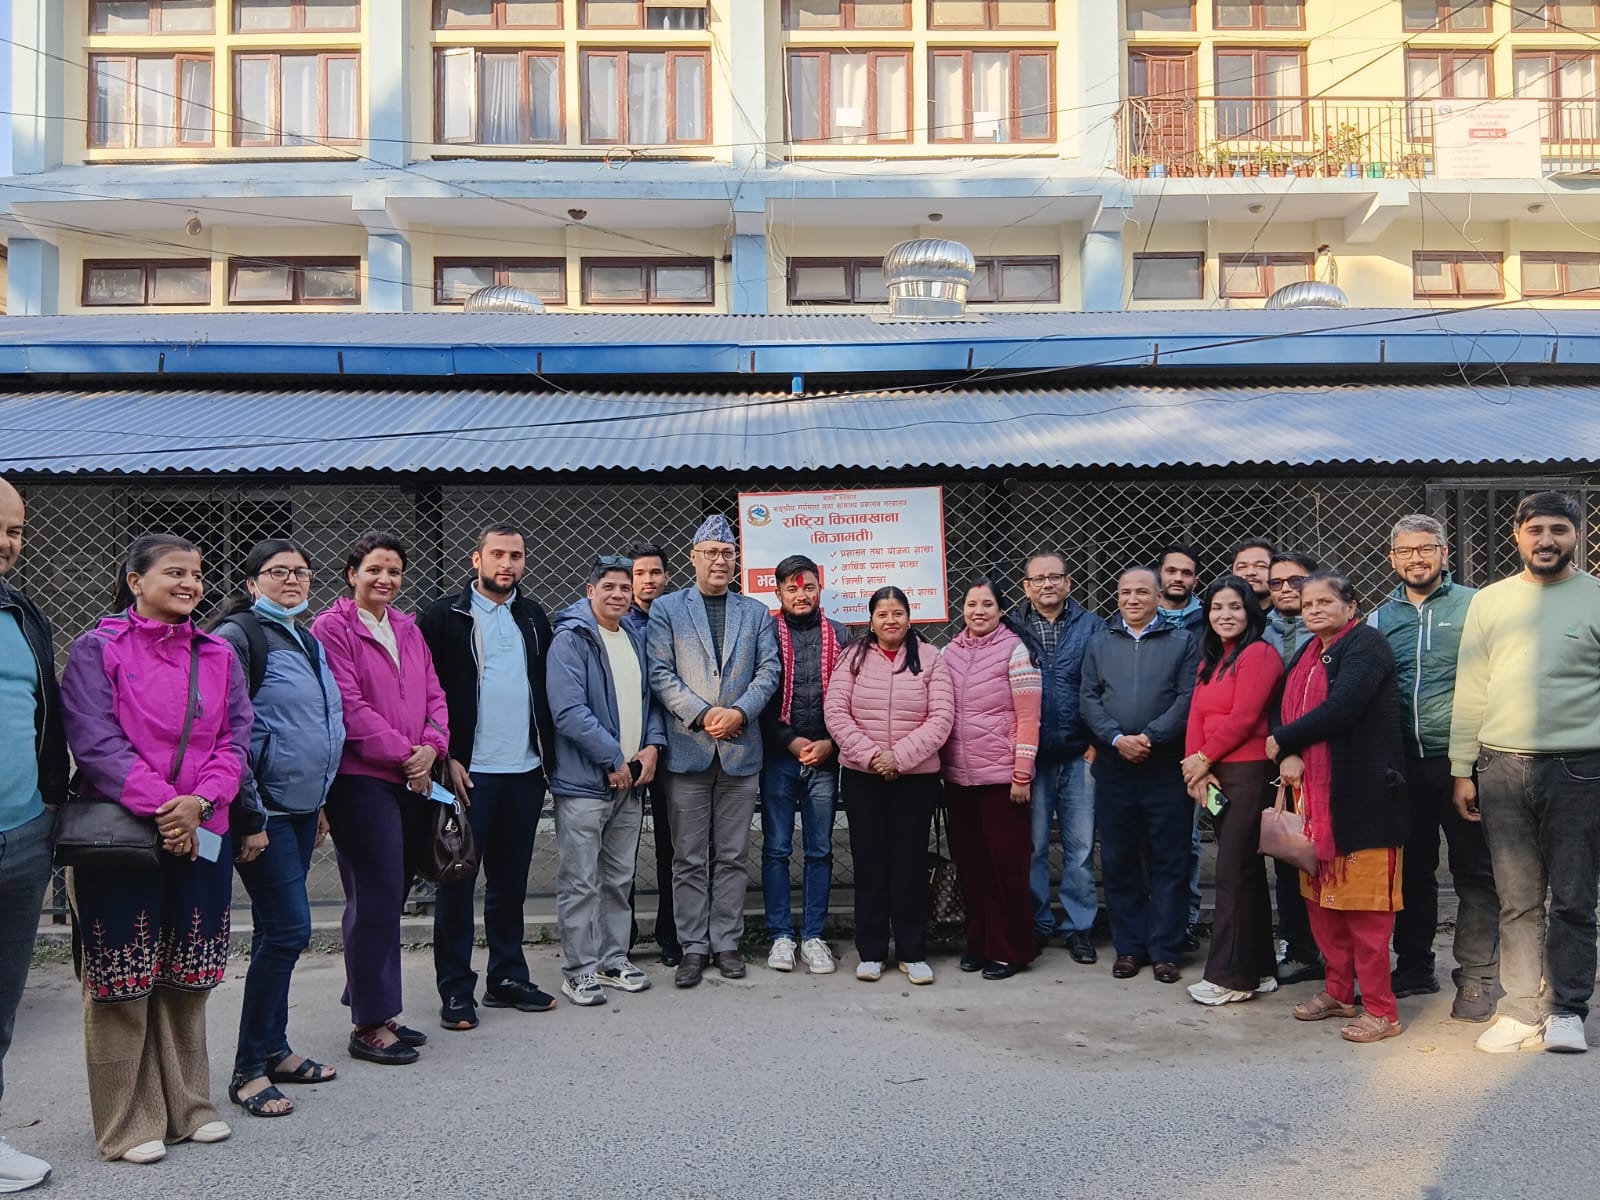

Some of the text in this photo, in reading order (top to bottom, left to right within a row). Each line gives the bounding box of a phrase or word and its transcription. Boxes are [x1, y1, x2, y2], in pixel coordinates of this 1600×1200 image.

[783, 513, 825, 529] राष्ट्रिय
[829, 512, 900, 525] किताबखाना
[810, 528, 873, 544] (निजामती)
[840, 545, 934, 557] प्रशासन तथा योजना शाखा
[841, 560, 918, 571] आर्थिक प्रशासन शाखा
[756, 574, 777, 588] भव
[867, 576, 886, 584] शाखा
[918, 587, 937, 597] शाखा
